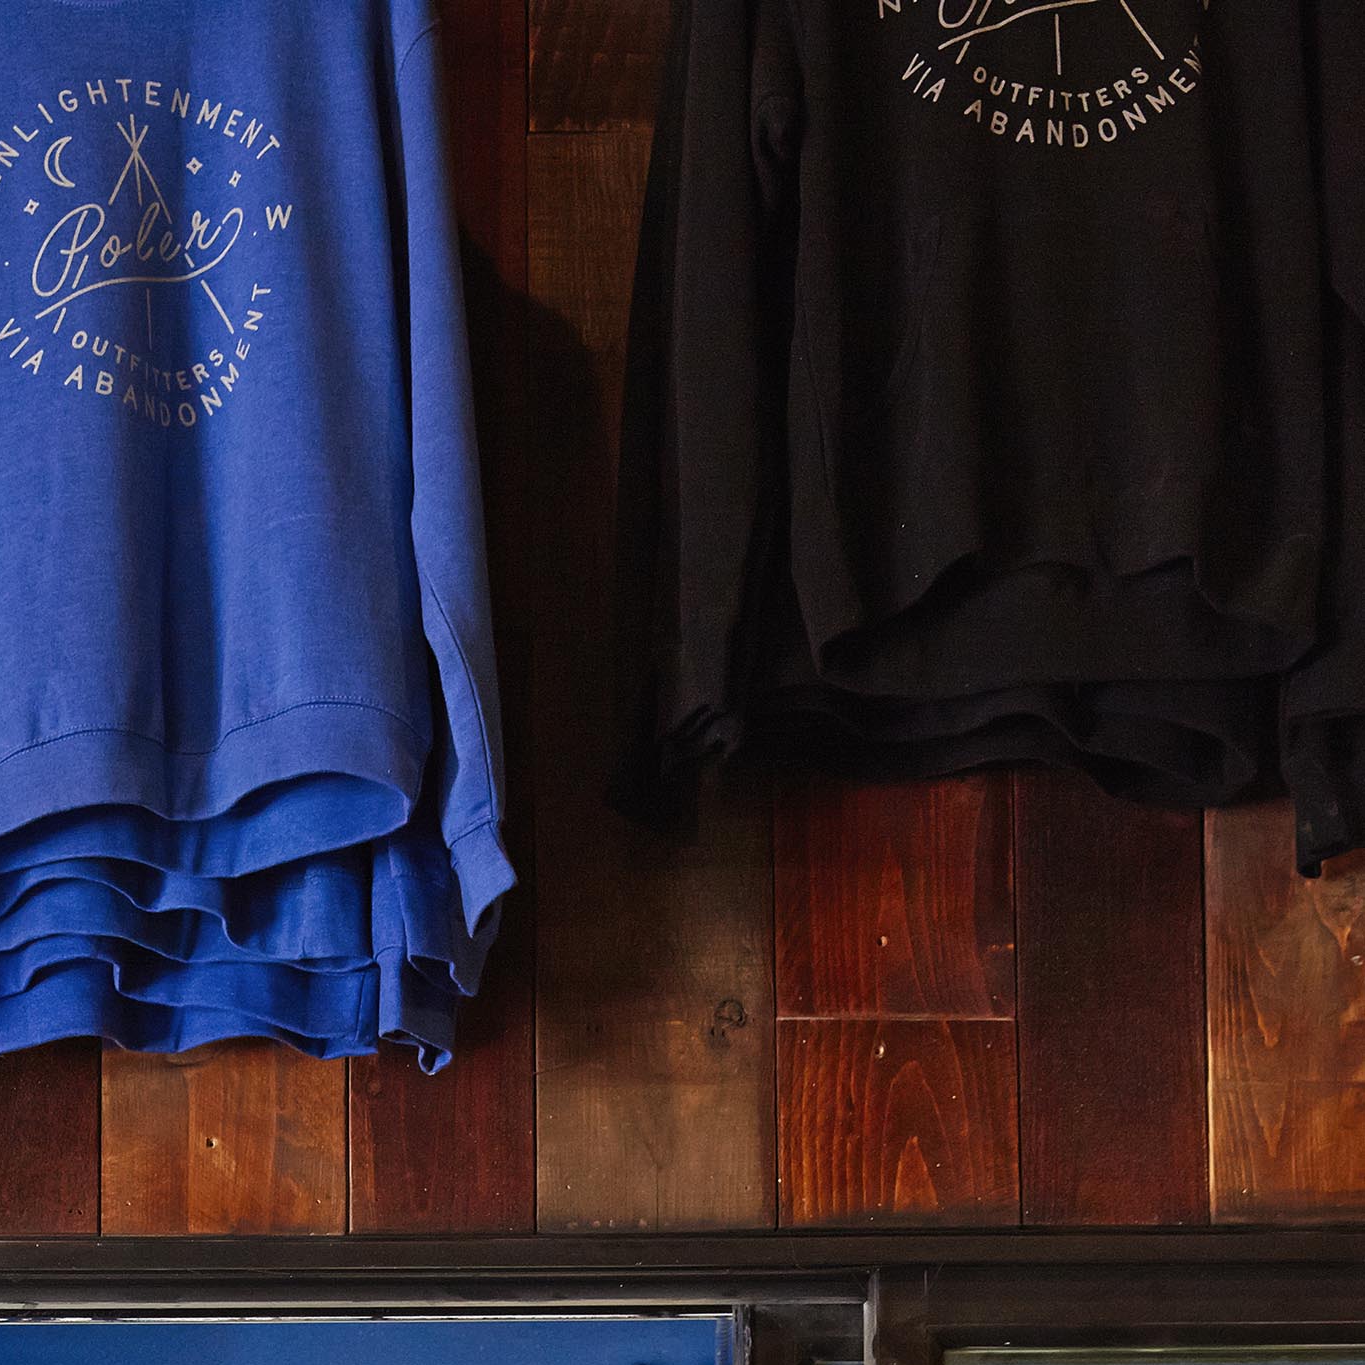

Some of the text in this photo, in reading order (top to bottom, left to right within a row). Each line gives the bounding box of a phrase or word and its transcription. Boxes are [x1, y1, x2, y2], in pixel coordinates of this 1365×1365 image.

[901, 53, 946, 102] VIA
[973, 66, 1150, 112] OUTFITTERS
[64, 284, 271, 426] ABANDONMENT
[72, 330, 222, 391] OUTFITTERS
